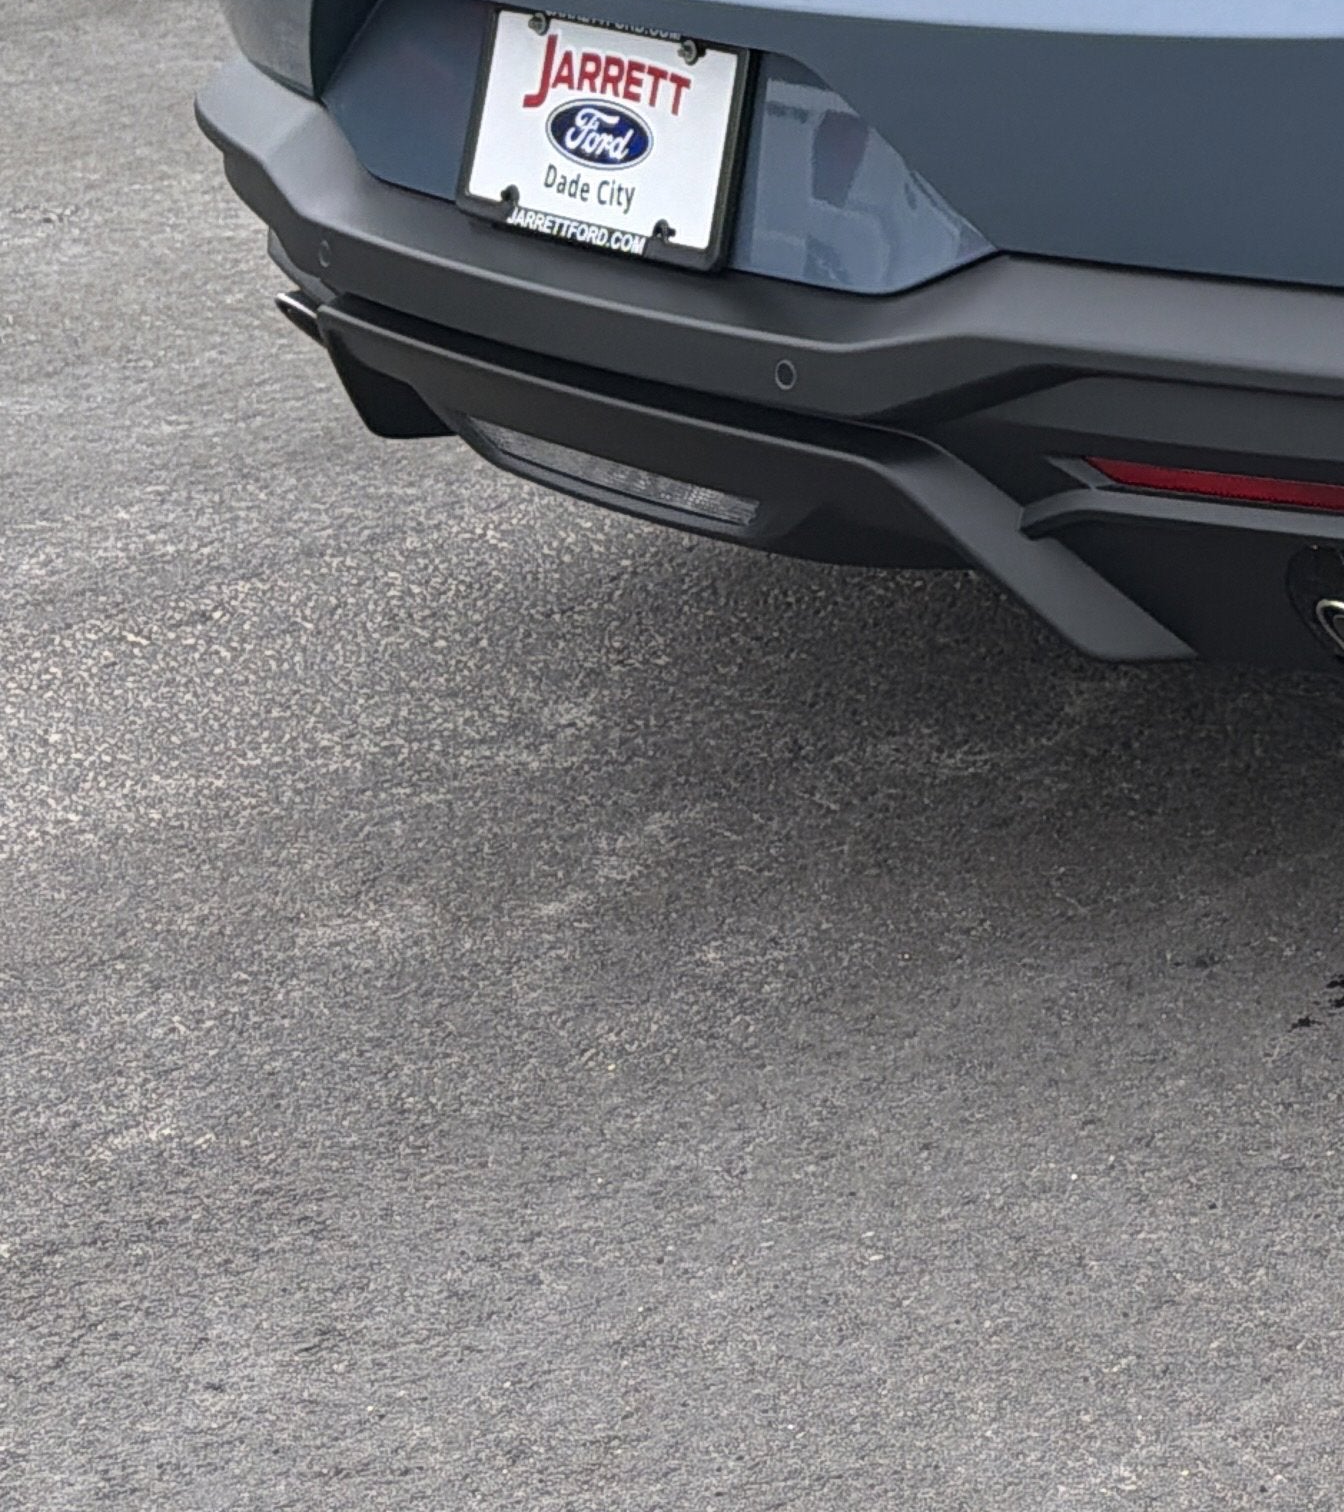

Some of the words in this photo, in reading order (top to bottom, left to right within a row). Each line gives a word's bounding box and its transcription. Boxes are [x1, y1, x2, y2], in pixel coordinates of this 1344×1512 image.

[522, 33, 692, 117] JARRETT
[564, 107, 635, 162] Ford
[543, 163, 591, 203] Dade
[597, 179, 636, 215] City
[506, 206, 647, 257] JARRETTFORD.COM
